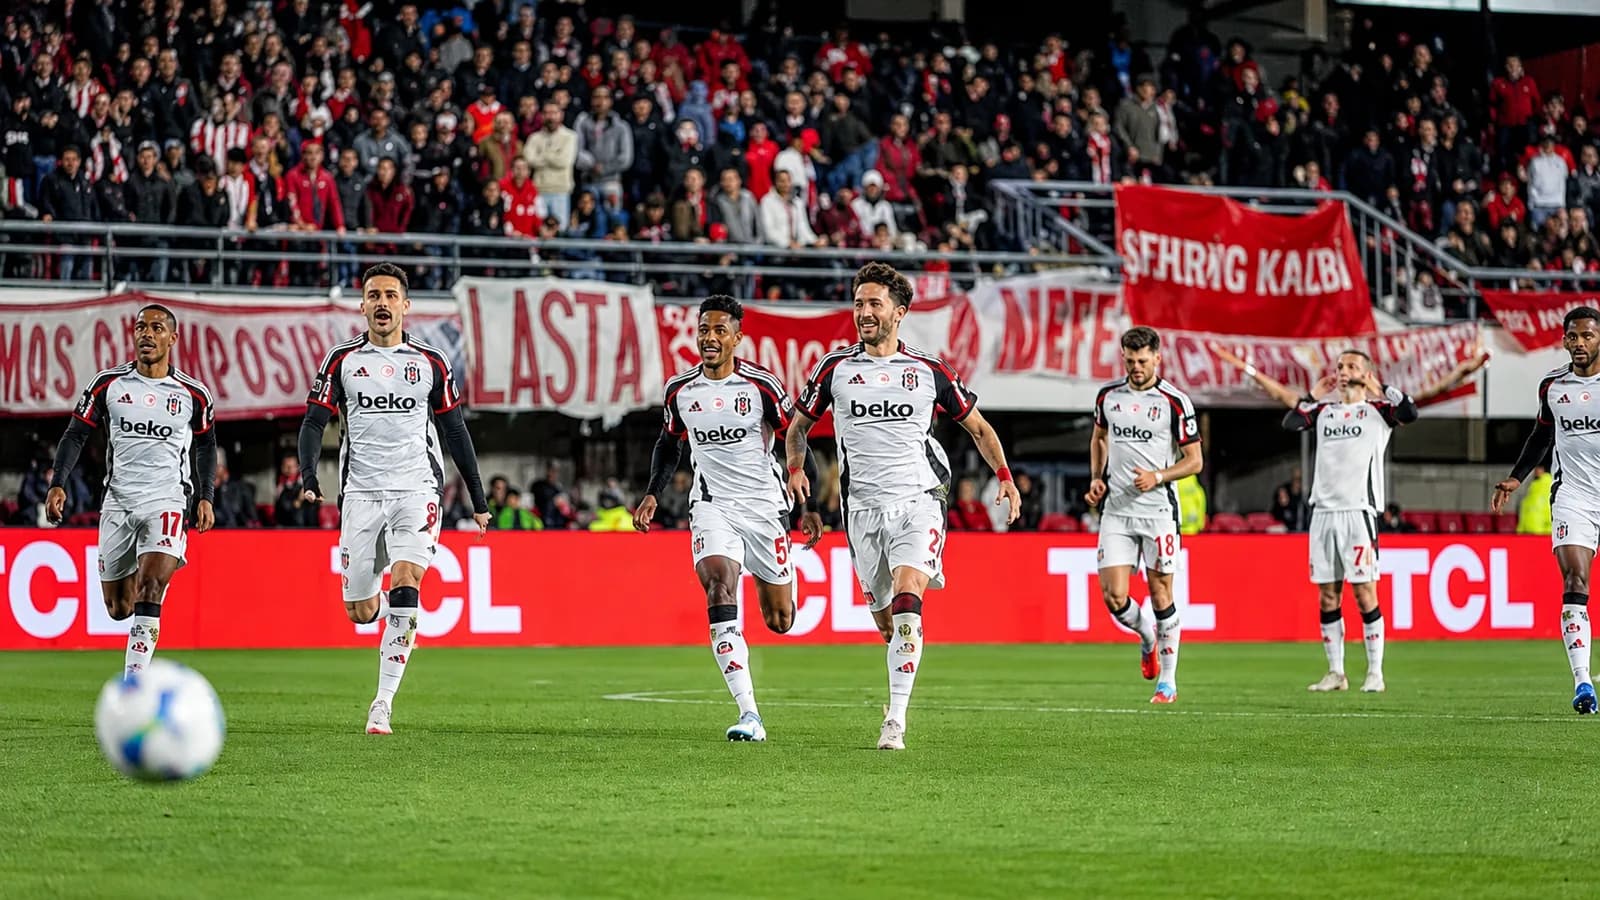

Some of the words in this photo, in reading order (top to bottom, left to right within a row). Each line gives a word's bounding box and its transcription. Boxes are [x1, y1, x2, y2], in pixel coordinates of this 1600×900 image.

[468, 287, 645, 406] LASTA
[358, 391, 417, 410] beko
[851, 400, 914, 418] beko
[119, 416, 173, 438] beko
[693, 425, 747, 443] beko
[1112, 422, 1153, 440] beko
[1323, 425, 1362, 437] beko
[159, 511, 181, 537] 17
[774, 535, 787, 566] 5
[1154, 533, 1175, 557] 18
[1353, 545, 1364, 567] 7
[0, 540, 130, 639] CL
[734, 543, 881, 637] CL
[1047, 547, 1216, 634] TL
[1378, 544, 1535, 633] TCL
